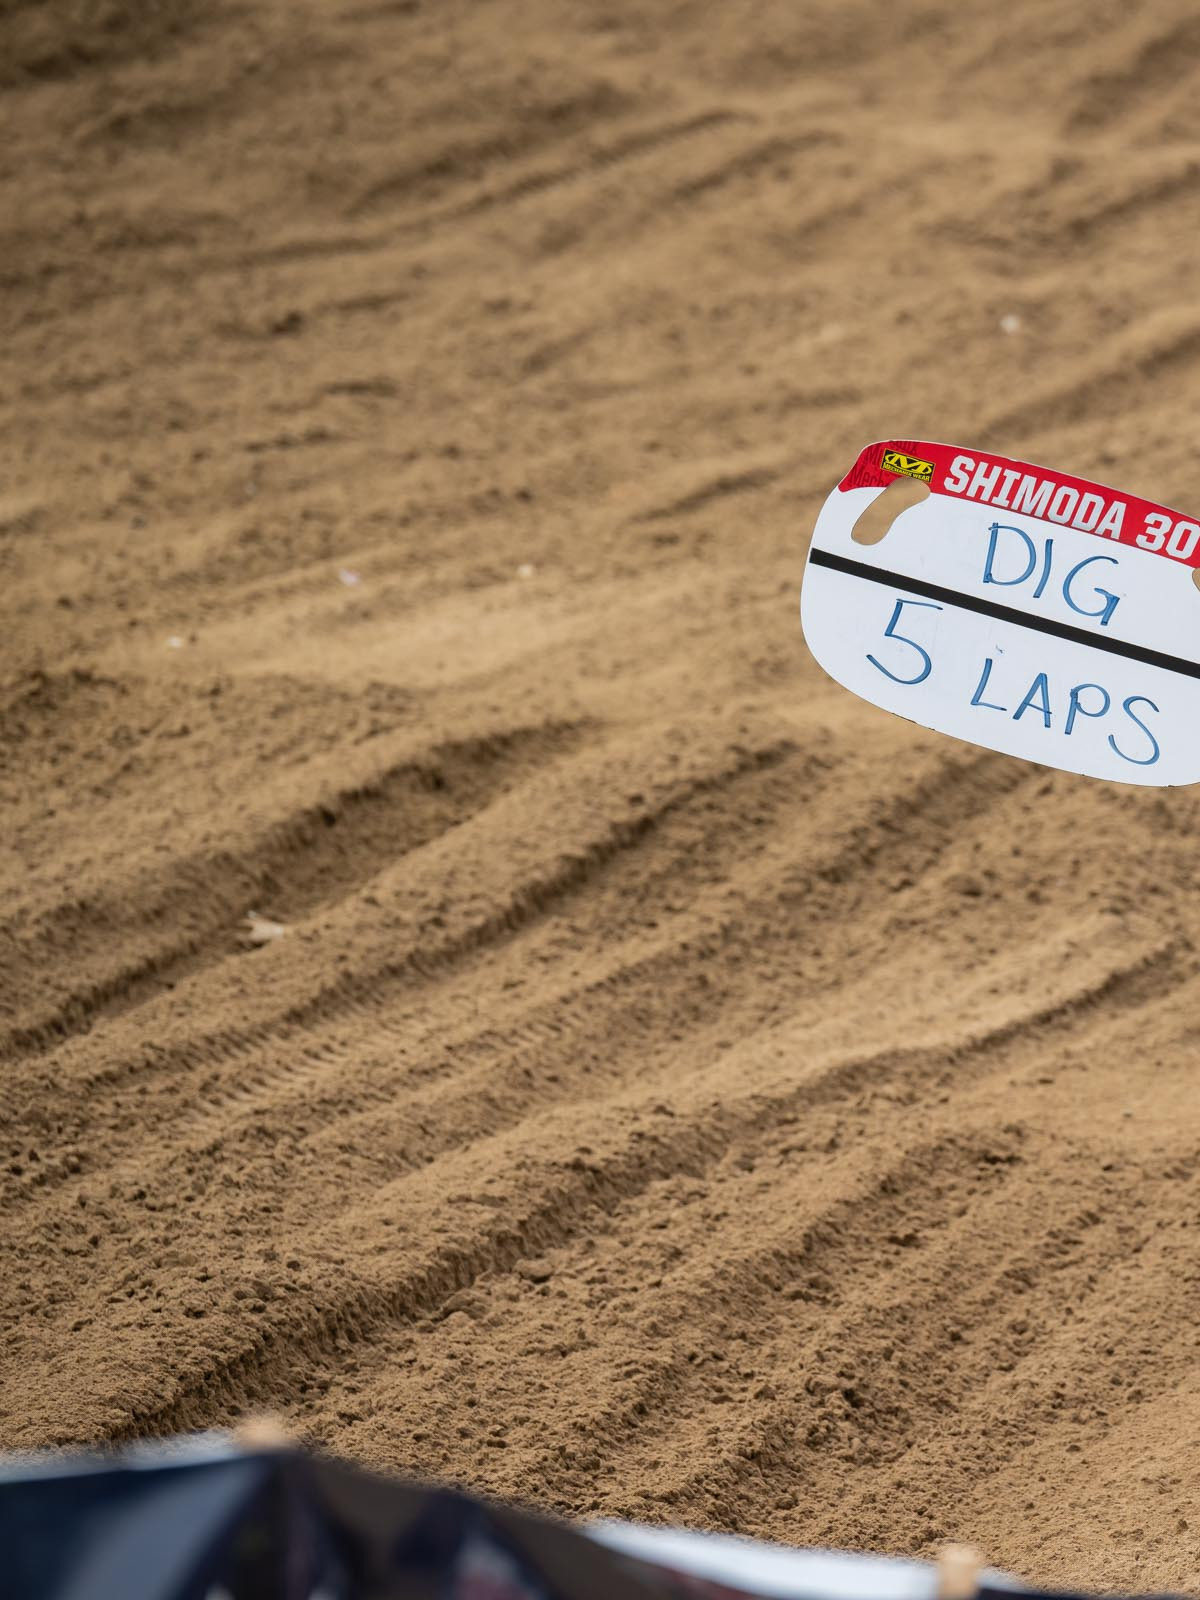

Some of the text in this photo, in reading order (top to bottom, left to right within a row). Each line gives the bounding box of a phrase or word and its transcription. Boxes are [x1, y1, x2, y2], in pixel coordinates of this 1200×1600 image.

[913, 472, 931, 482] WEAR
[944, 455, 1126, 540] SHIMODA
[982, 521, 1121, 626] DIG
[865, 597, 1161, 766] 5 LAPS
